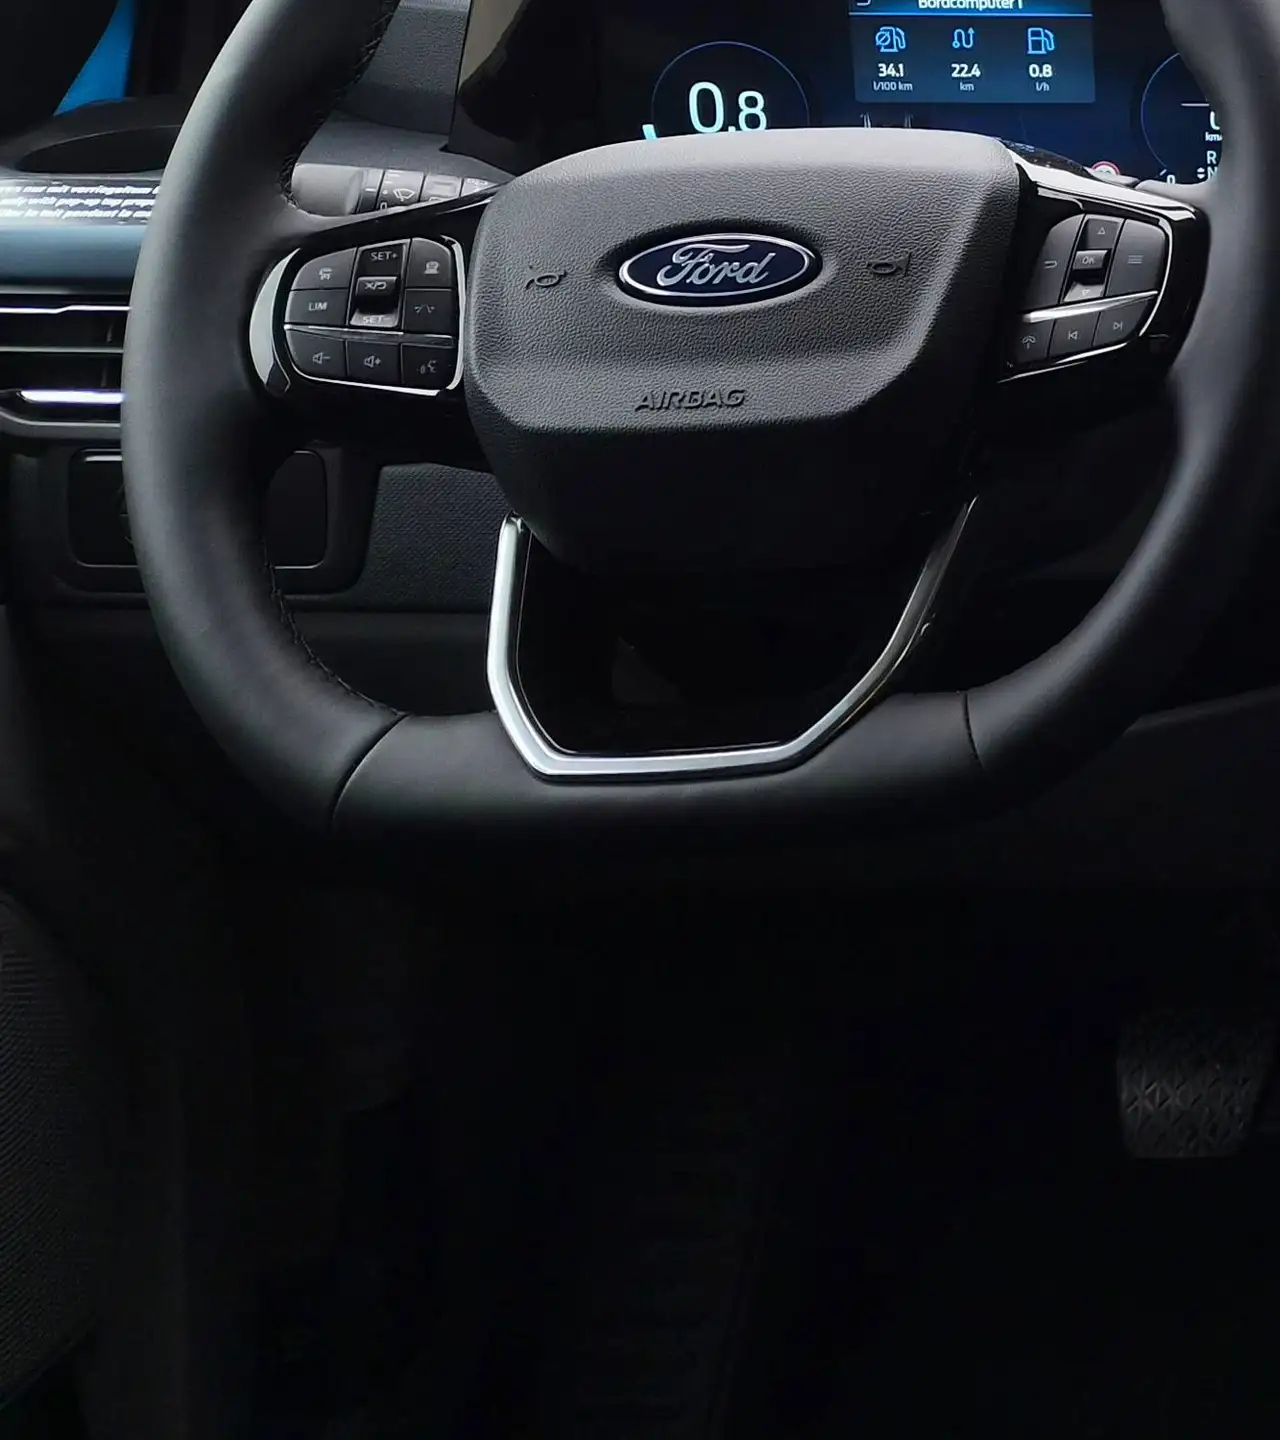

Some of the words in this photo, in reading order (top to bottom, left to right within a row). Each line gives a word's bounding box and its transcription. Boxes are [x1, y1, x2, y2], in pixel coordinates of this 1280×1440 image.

[877, 64, 904, 78] 34.1
[951, 64, 982, 78] 22.4
[1028, 64, 1053, 78] 0.8
[898, 81, 913, 91] km
[960, 82, 975, 91] km
[688, 81, 767, 133] 0.8
[371, 251, 398, 260] SET+
[1082, 256, 1095, 265] OK
[656, 243, 776, 287] Ford
[309, 302, 328, 310] LIM
[635, 389, 747, 411] AIRBAG
